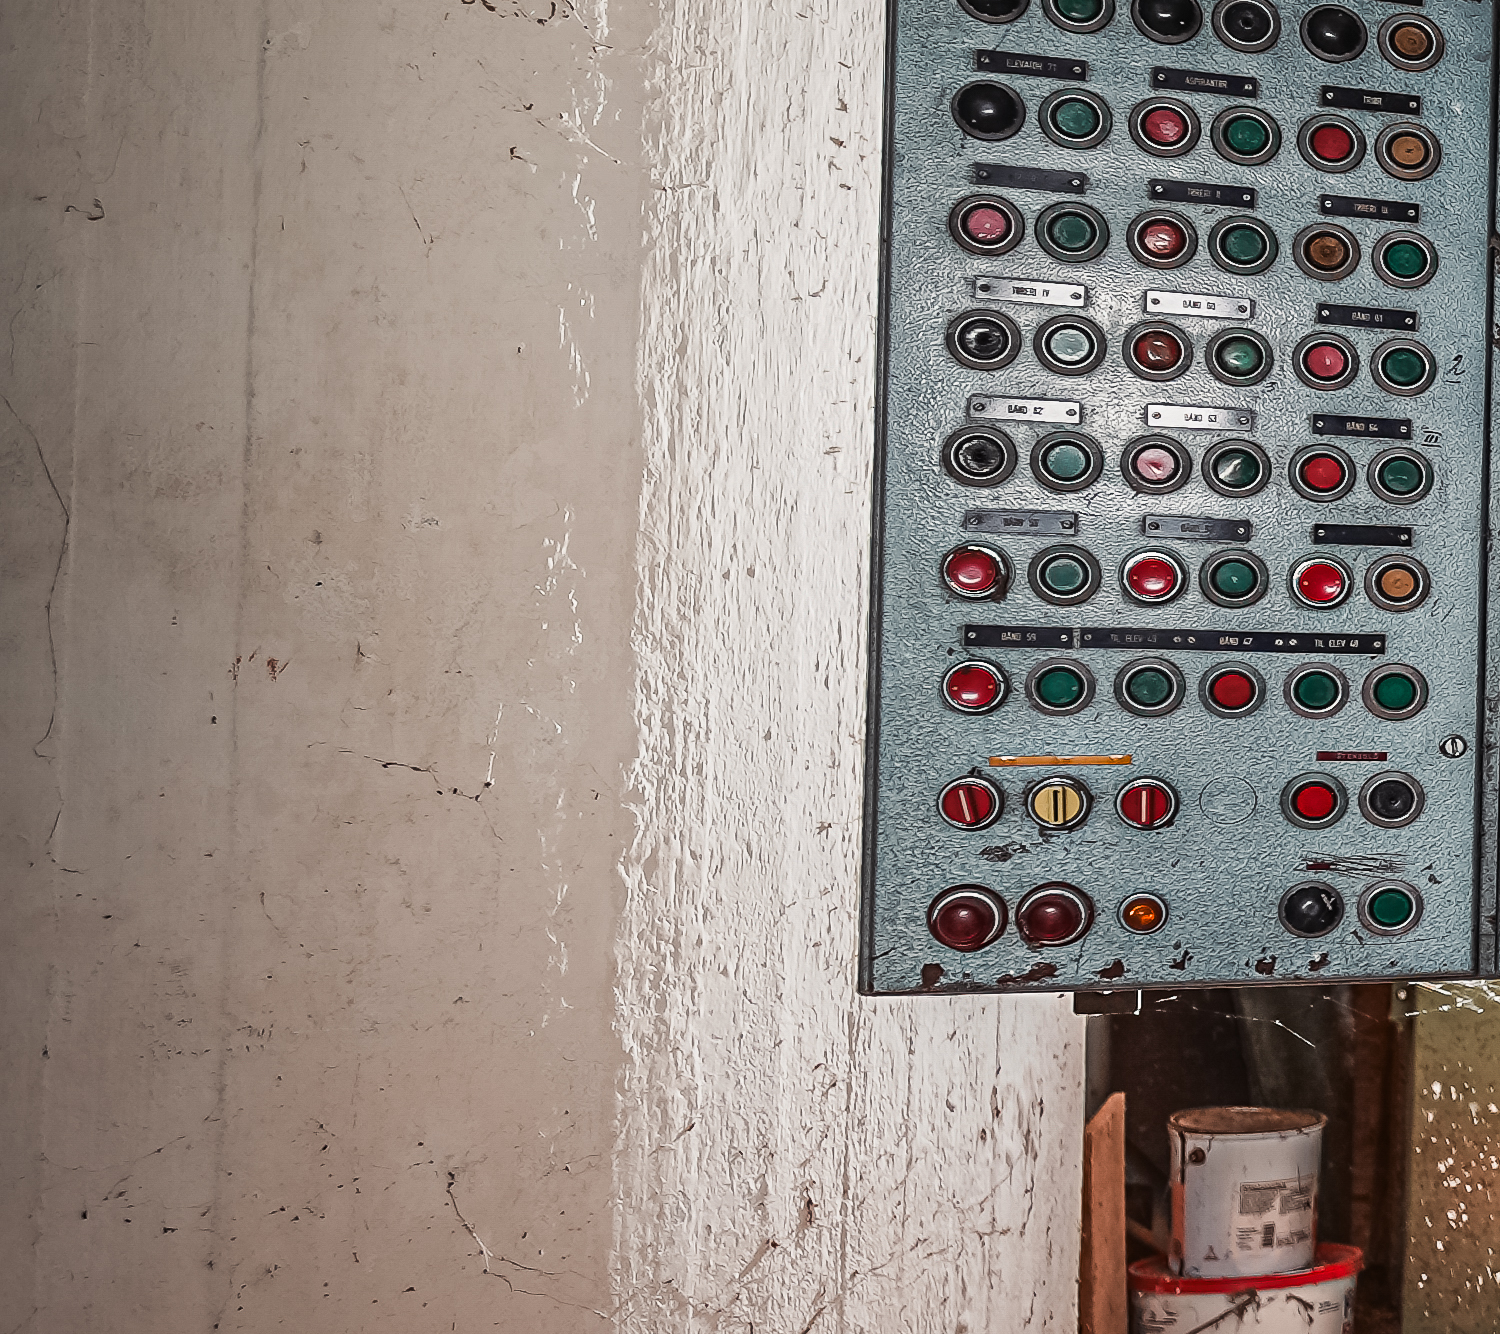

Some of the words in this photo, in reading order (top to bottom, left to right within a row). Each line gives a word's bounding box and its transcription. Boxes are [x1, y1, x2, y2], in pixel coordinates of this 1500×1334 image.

[1006, 58, 1043, 71] ELEVATOR
[1314, 638, 1325, 648] TIL
[1328, 638, 1346, 648] ELEV
